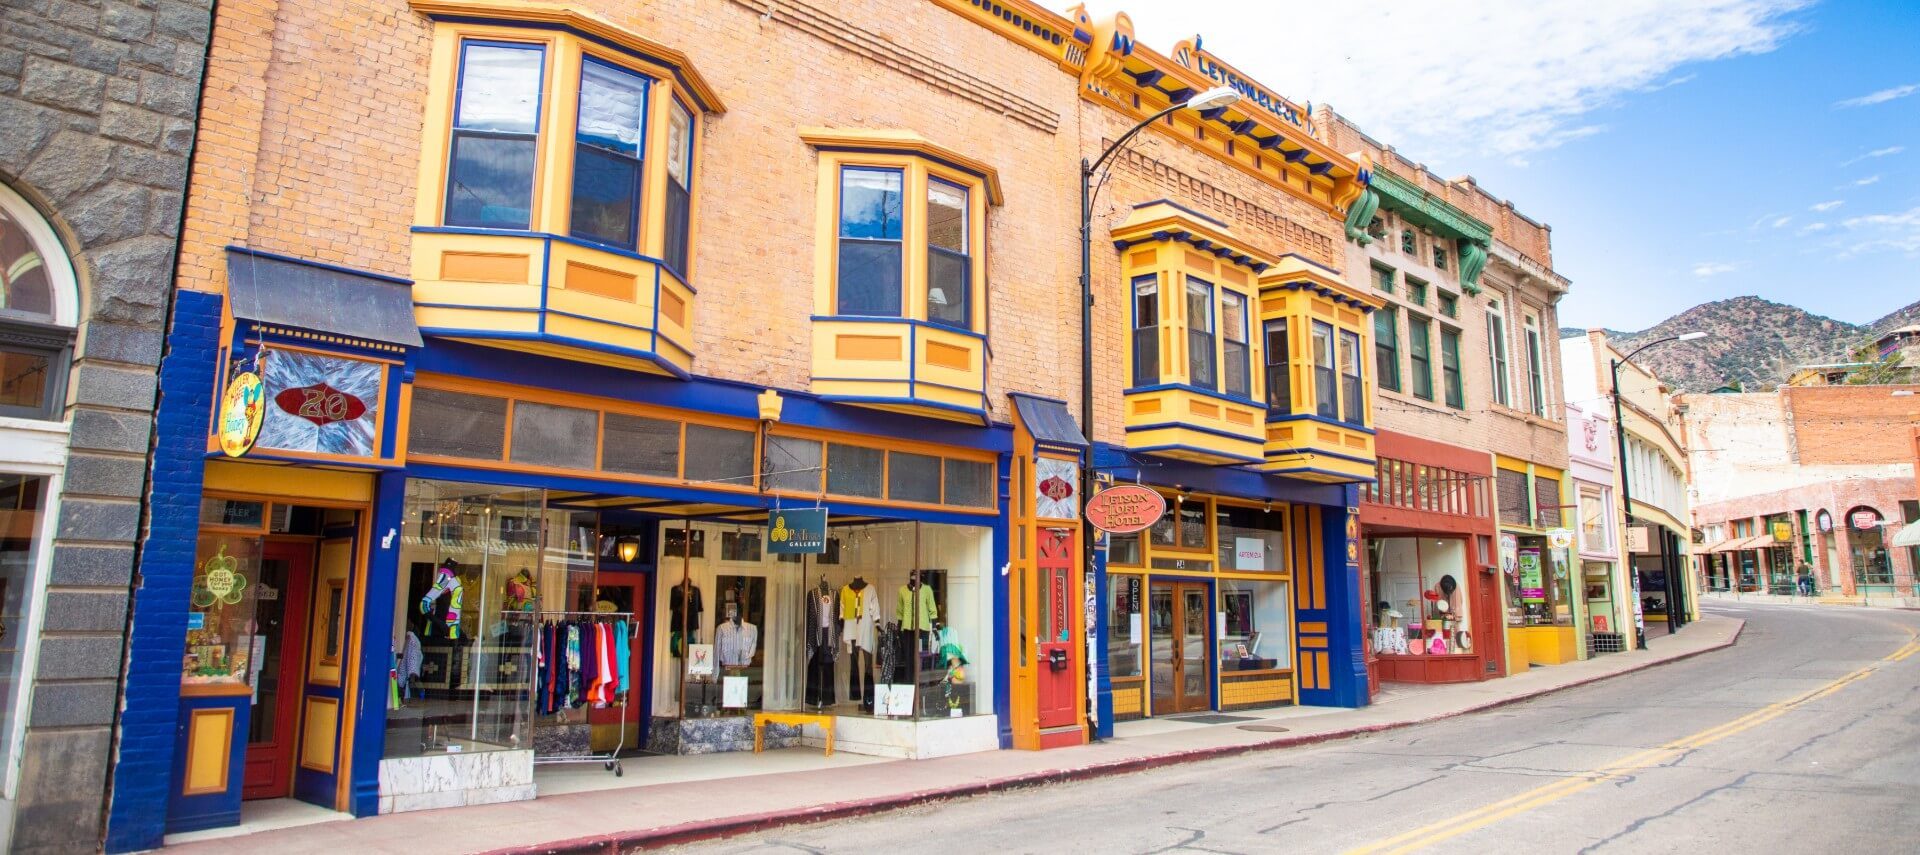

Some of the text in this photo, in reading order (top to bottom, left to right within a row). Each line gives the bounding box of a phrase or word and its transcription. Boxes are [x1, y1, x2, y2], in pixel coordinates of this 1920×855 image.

[298, 388, 348, 421] 20
[1101, 493, 1149, 506] LETSON
[1108, 504, 1139, 517] LOFT
[1104, 515, 1146, 529] HOTEL
